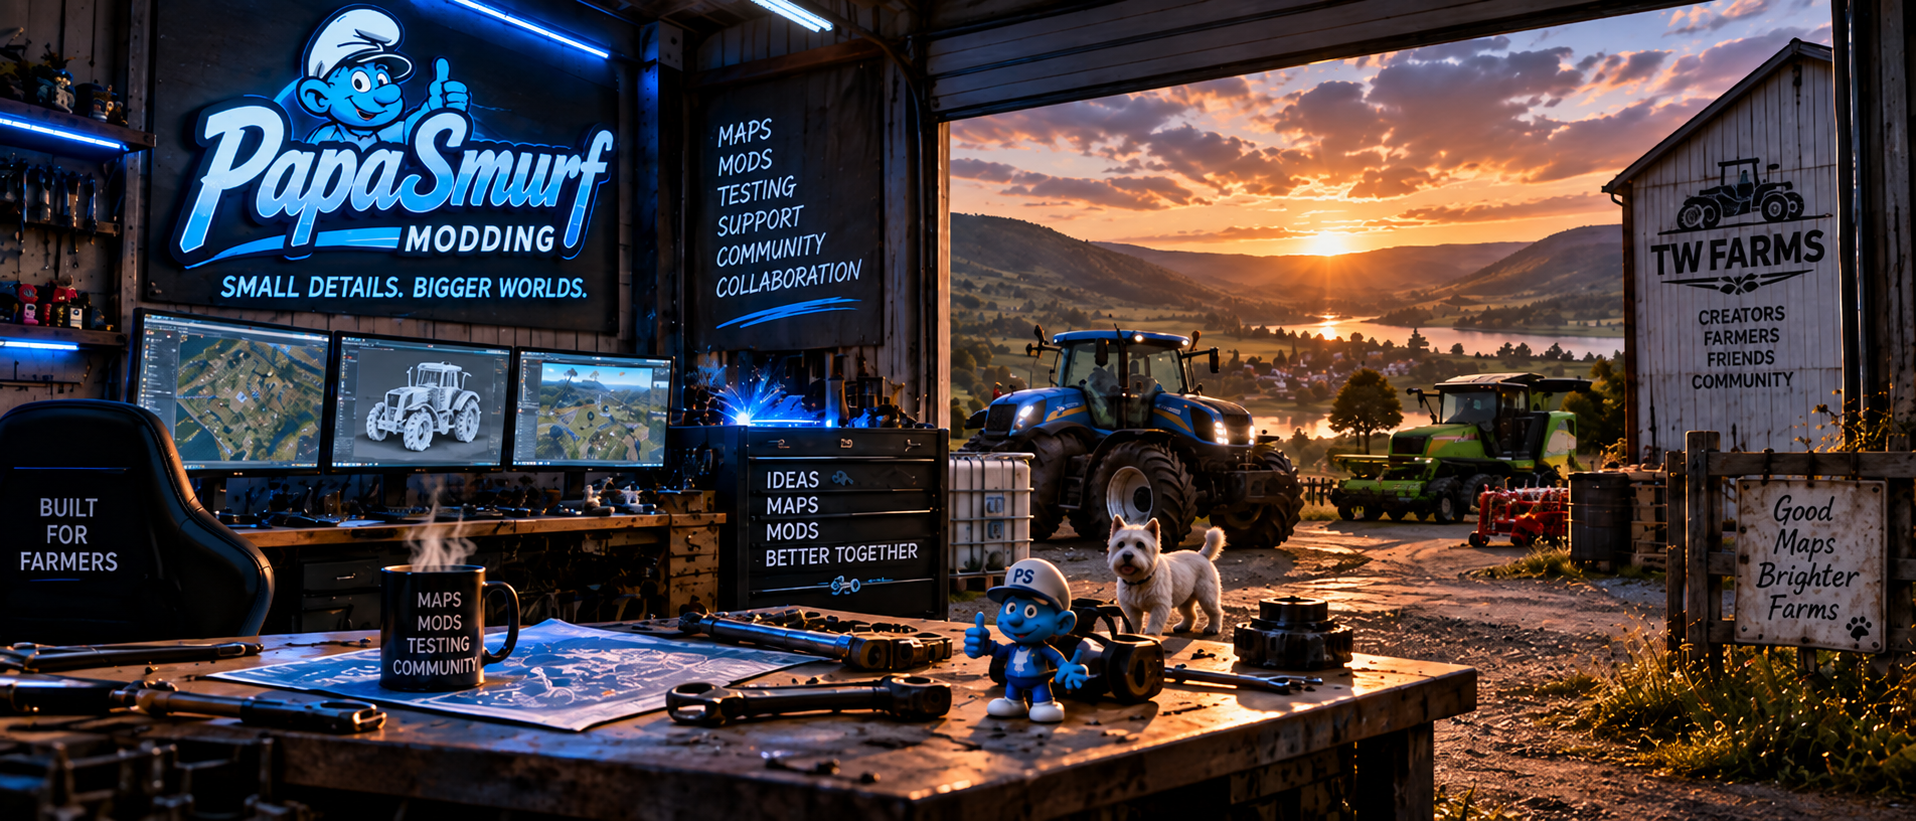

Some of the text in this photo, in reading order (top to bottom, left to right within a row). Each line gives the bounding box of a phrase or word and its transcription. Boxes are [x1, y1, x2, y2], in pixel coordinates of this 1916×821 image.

[717, 117, 773, 148] MAPS
[717, 148, 773, 177] MODS
[716, 175, 797, 207] TESTING
[716, 205, 805, 237] SUPPORT
[404, 225, 556, 253] MODDING
[716, 232, 827, 267] COMMUNITY
[1650, 229, 1826, 276] TW FARMS
[220, 275, 588, 299] SMALL DETAILS. BIGGER WORLDS.
[715, 258, 863, 298] COLLABORATION
[1698, 305, 1786, 326] CREATORS
[1703, 327, 1781, 347] FARMERS
[1707, 350, 1776, 368] FRIENDS
[1691, 371, 1795, 390] COMMUNITY
[766, 470, 820, 489] IDEAS
[39, 497, 98, 518] BUILT
[766, 496, 819, 515] MAPS
[1773, 494, 1836, 526] Good
[46, 524, 88, 545] FOR
[766, 521, 820, 541] MODS
[765, 542, 919, 568] BETTER TOGETHER
[1773, 528, 1836, 563] Maps
[20, 551, 118, 572] FARMERS
[1013, 568, 1035, 584] PS
[1755, 561, 1861, 596] Brighter
[417, 591, 462, 608] MAPS
[1767, 593, 1840, 621] Farms
[417, 614, 463, 632] MODS
[406, 635, 470, 654] TESTING
[392, 656, 478, 676] COMMUNITY
